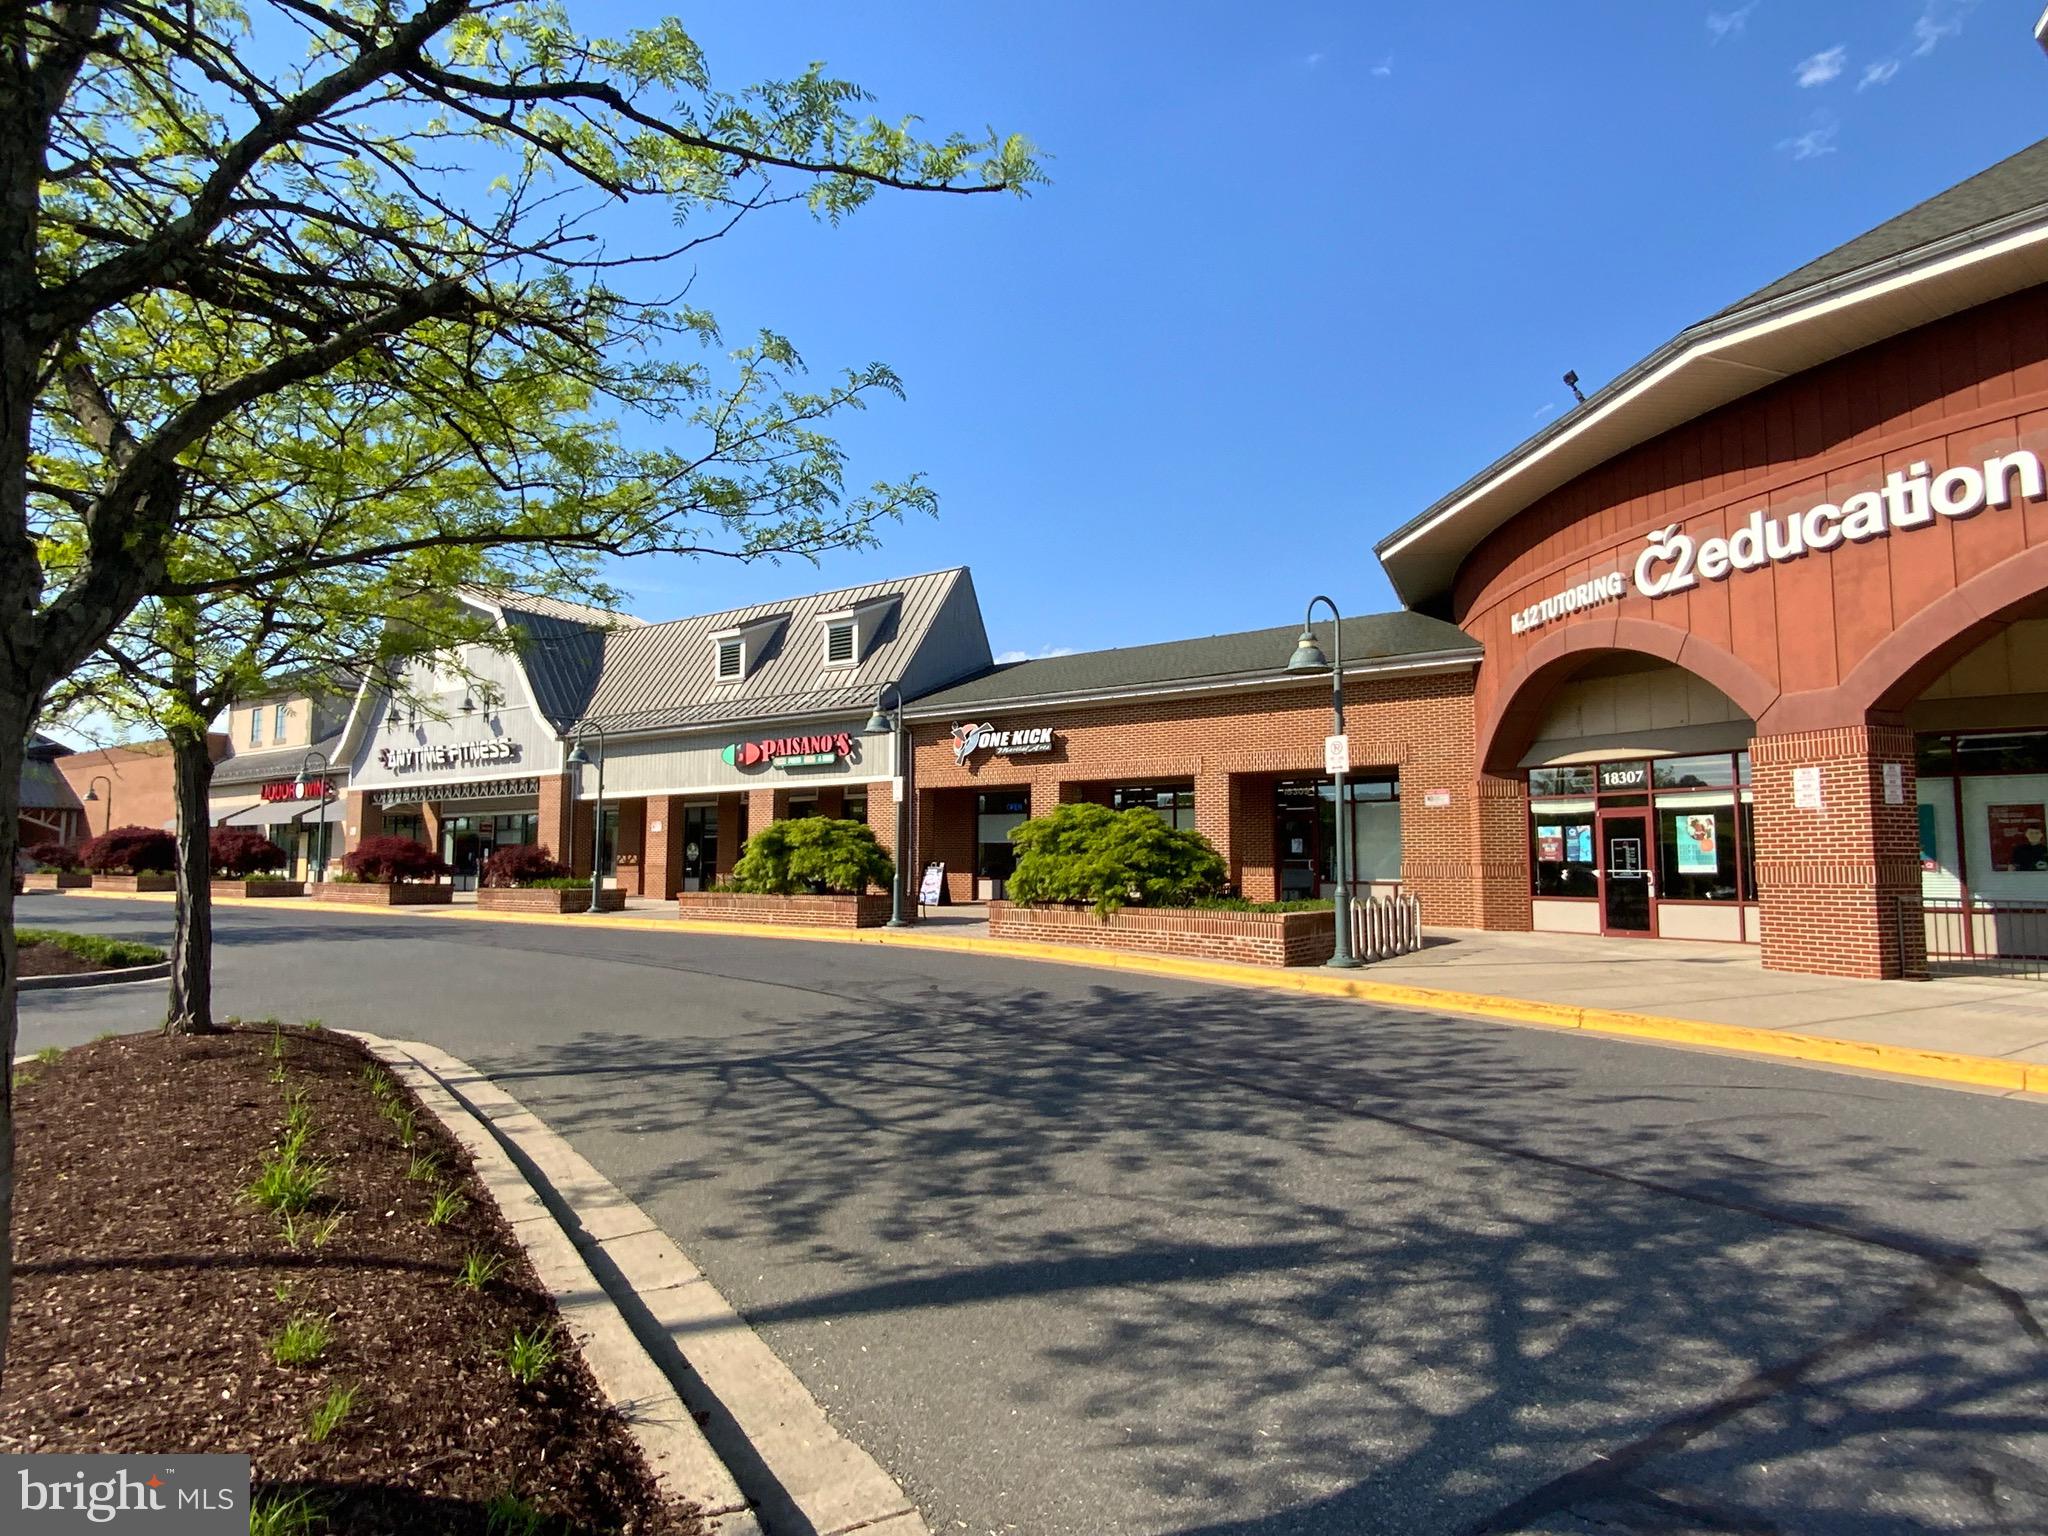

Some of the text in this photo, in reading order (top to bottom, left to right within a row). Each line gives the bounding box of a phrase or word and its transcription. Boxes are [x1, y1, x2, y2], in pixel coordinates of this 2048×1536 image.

[1539, 571, 1624, 621] TUTORING
[1634, 526, 1697, 598] C2
[1697, 449, 2044, 578] education
[761, 732, 850, 762] PAISANO'S
[979, 727, 1053, 748] ONE KICK
[387, 744, 446, 767] ANYTIME
[1603, 770, 1644, 785] 18307
[261, 782, 295, 800] LIQUOR
